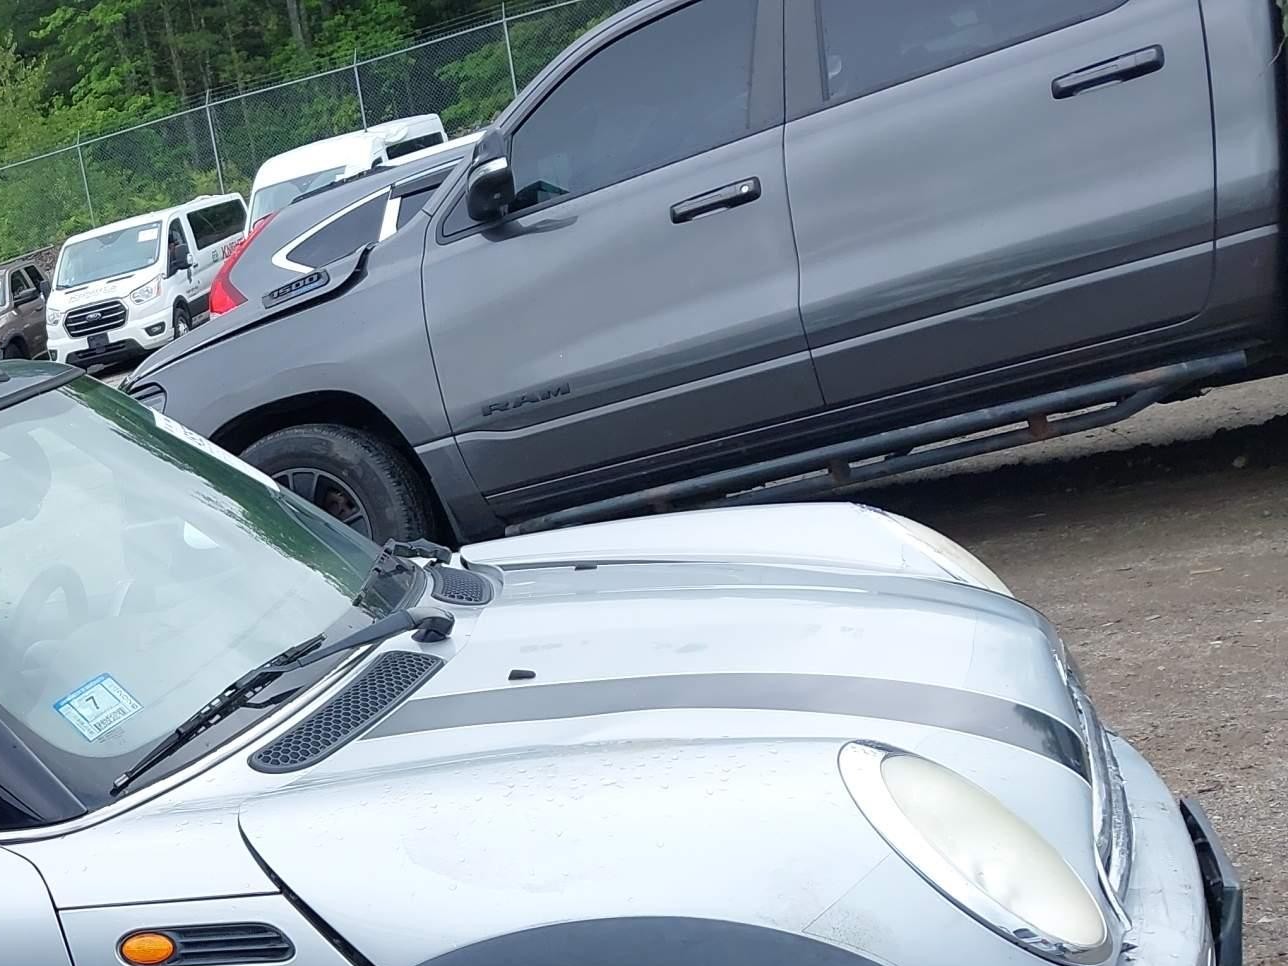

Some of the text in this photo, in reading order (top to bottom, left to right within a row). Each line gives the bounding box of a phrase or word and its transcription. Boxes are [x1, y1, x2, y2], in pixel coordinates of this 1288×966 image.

[273, 273, 318, 298] 1500
[481, 382, 571, 416] RAM
[84, 695, 100, 710] 7
